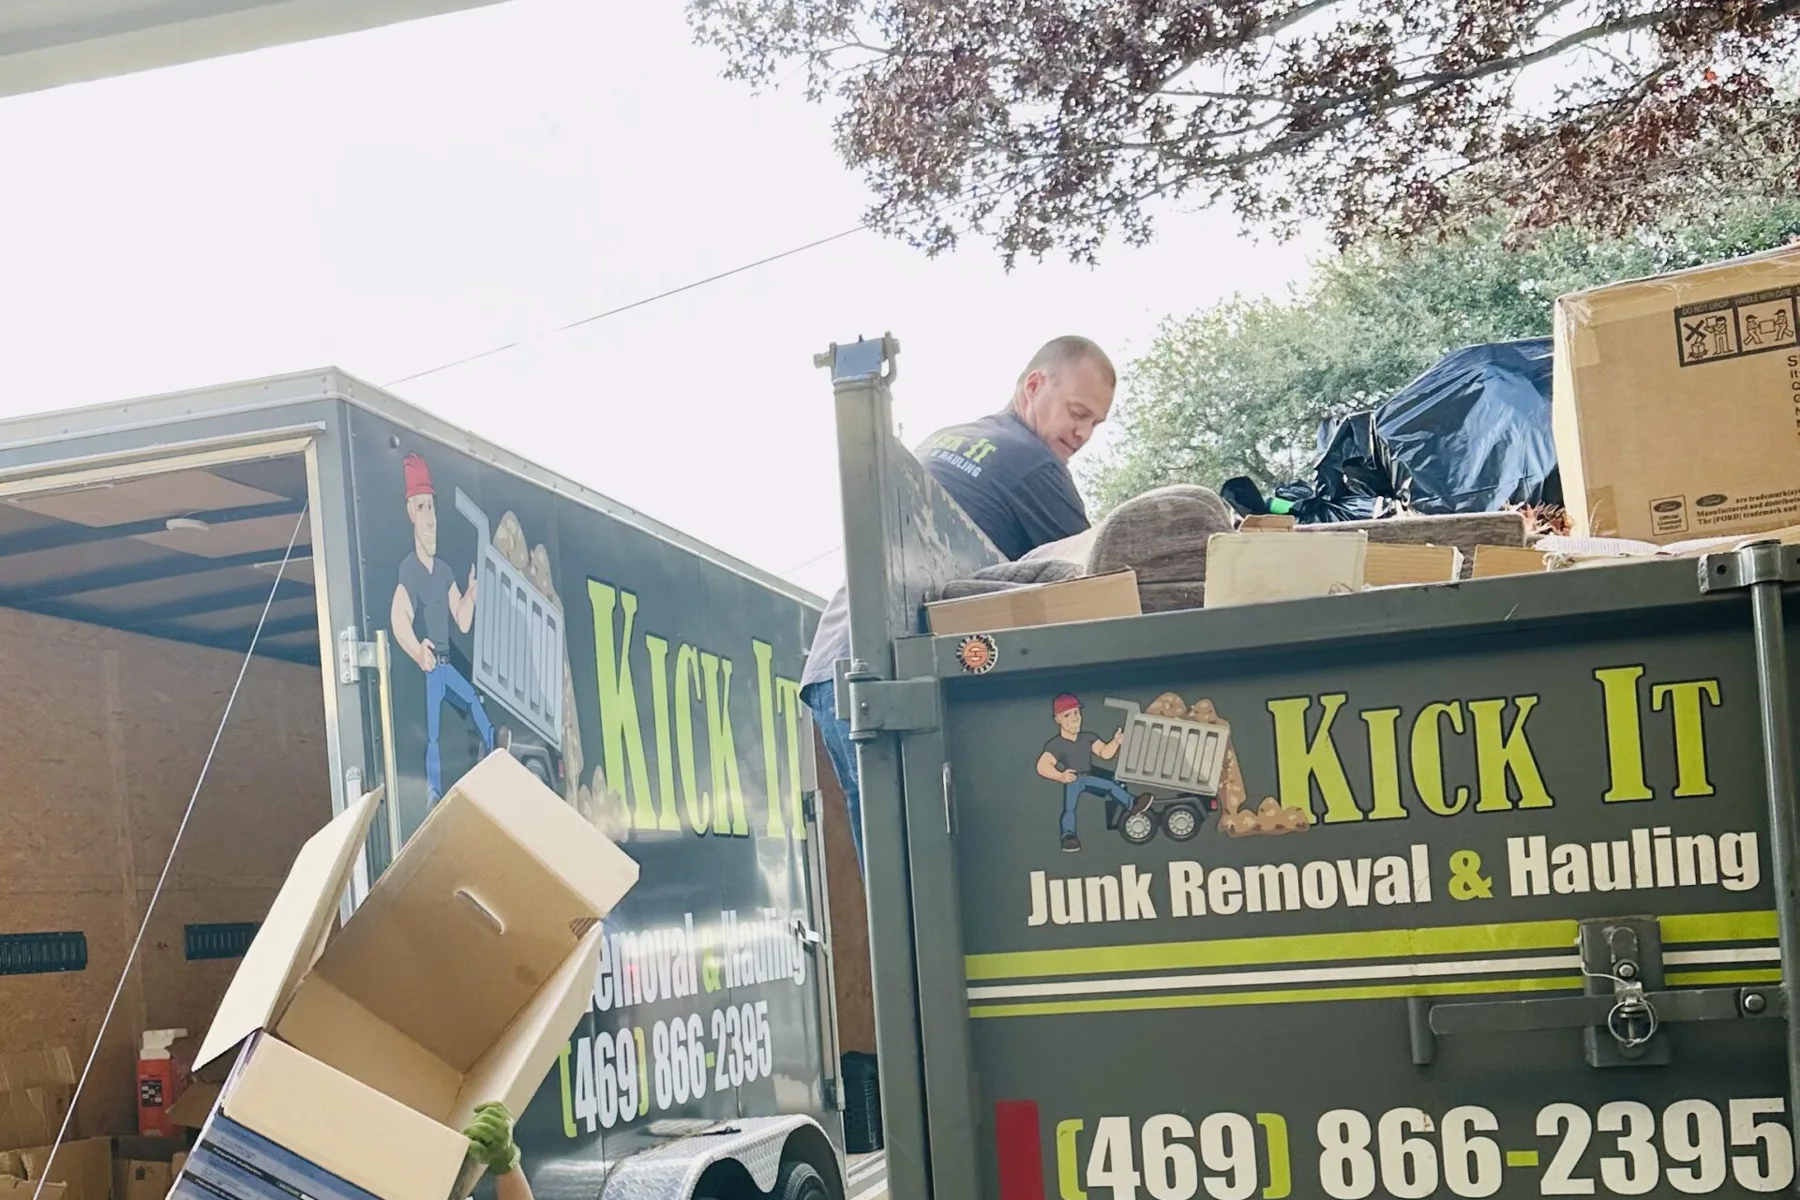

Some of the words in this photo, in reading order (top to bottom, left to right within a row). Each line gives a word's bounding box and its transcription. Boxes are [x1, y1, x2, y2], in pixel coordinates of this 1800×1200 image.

[938, 450, 982, 478] HAULING
[1697, 504, 1748, 517] Manufactured
[589, 577, 748, 837] KICK
[752, 638, 806, 839] IT
[1267, 691, 1554, 826] KICK
[1596, 665, 1721, 803] IT
[1027, 865, 1156, 927] Junk
[1168, 844, 1432, 918] Removal
[1447, 849, 1493, 901] &
[1507, 826, 1761, 896] Hauling
[585, 912, 698, 1012] emoval
[560, 1027, 649, 1138] (469)
[653, 1001, 772, 1110] 866-2395
[1317, 1098, 1795, 1200] 866-2395
